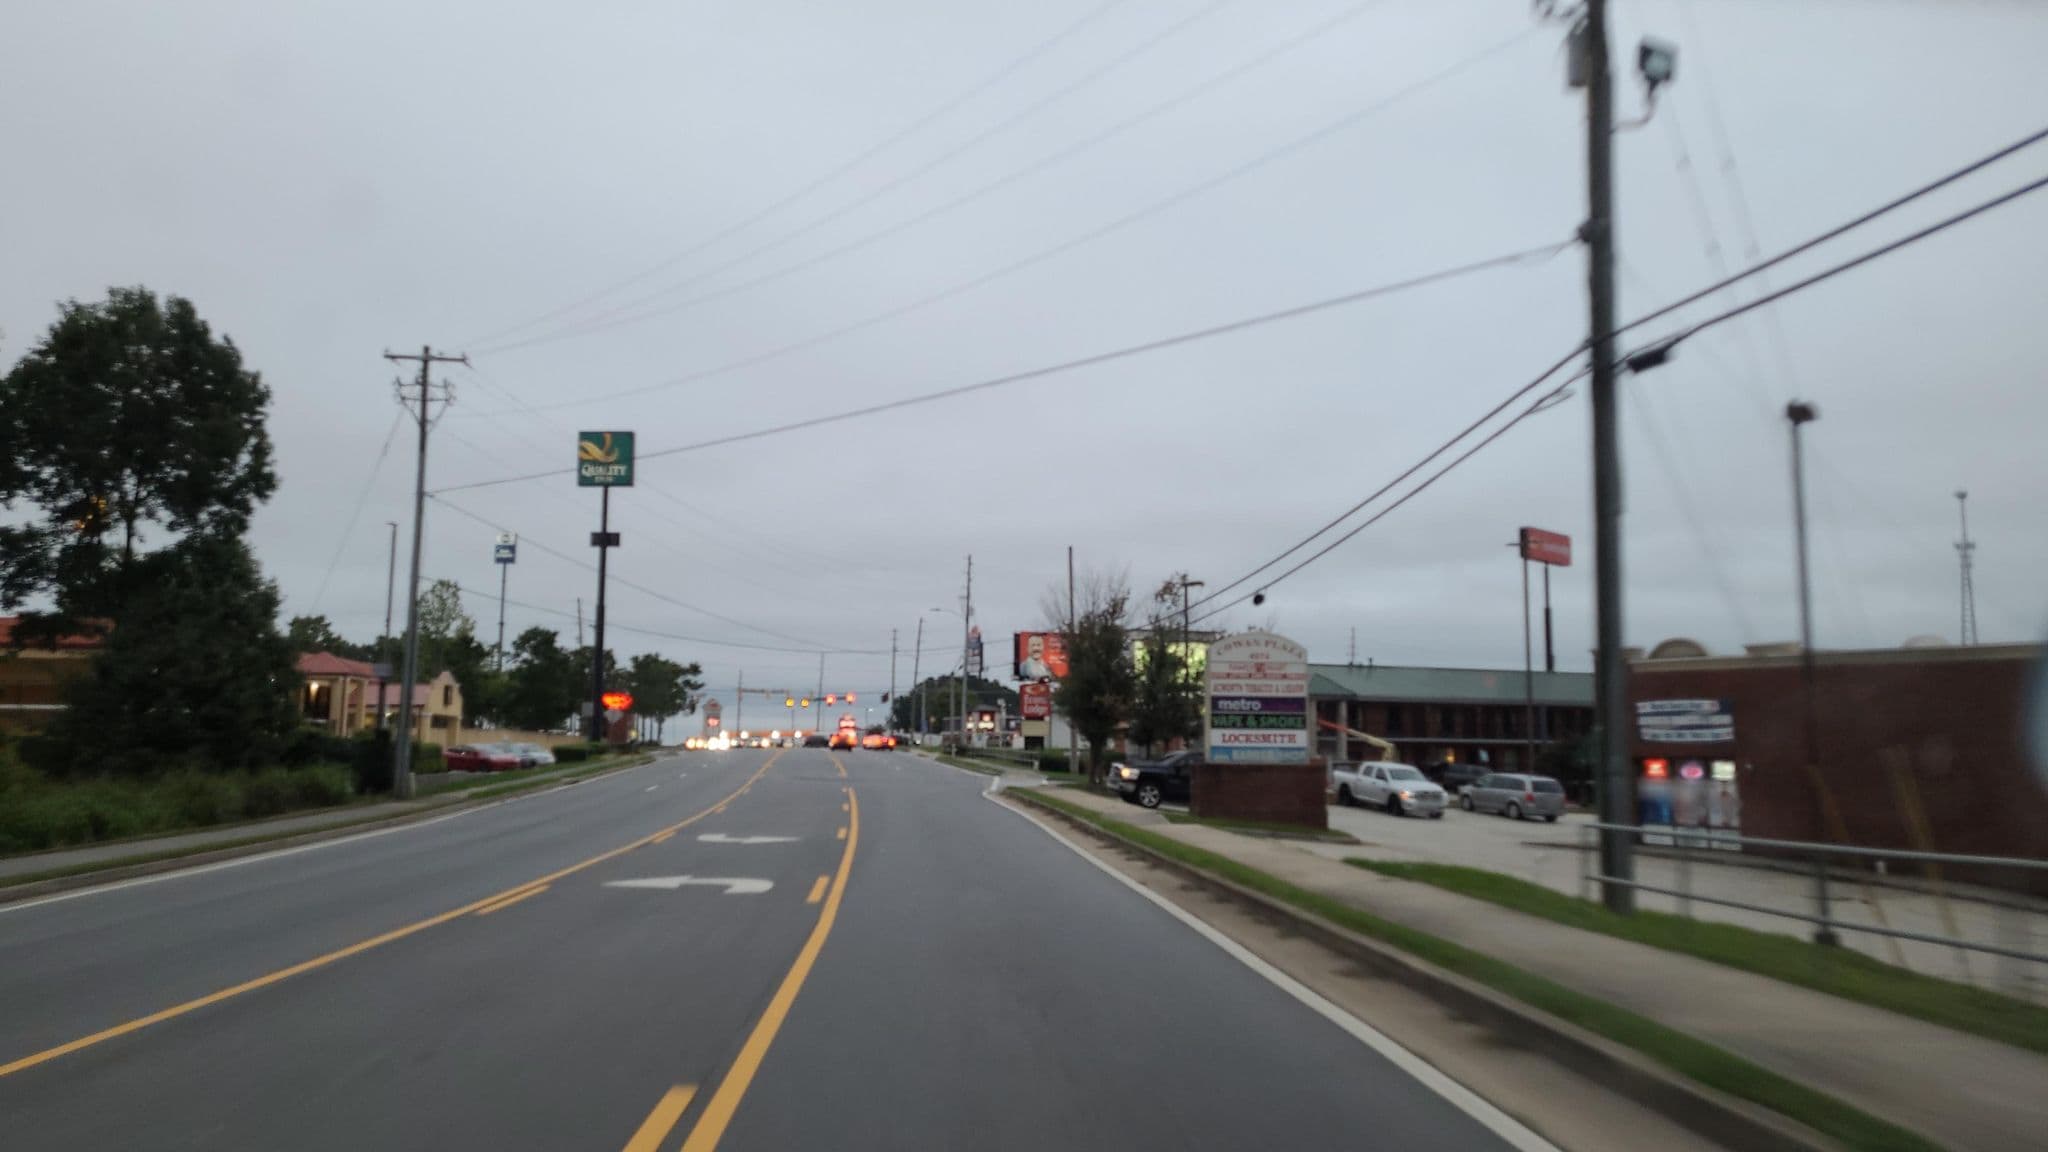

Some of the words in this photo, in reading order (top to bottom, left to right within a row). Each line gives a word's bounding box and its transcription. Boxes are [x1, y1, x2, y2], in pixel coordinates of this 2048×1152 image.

[1218, 699, 1262, 711] metro
[1260, 715, 1304, 727] SMOKE
[1222, 733, 1296, 744] LOCKSMITH
